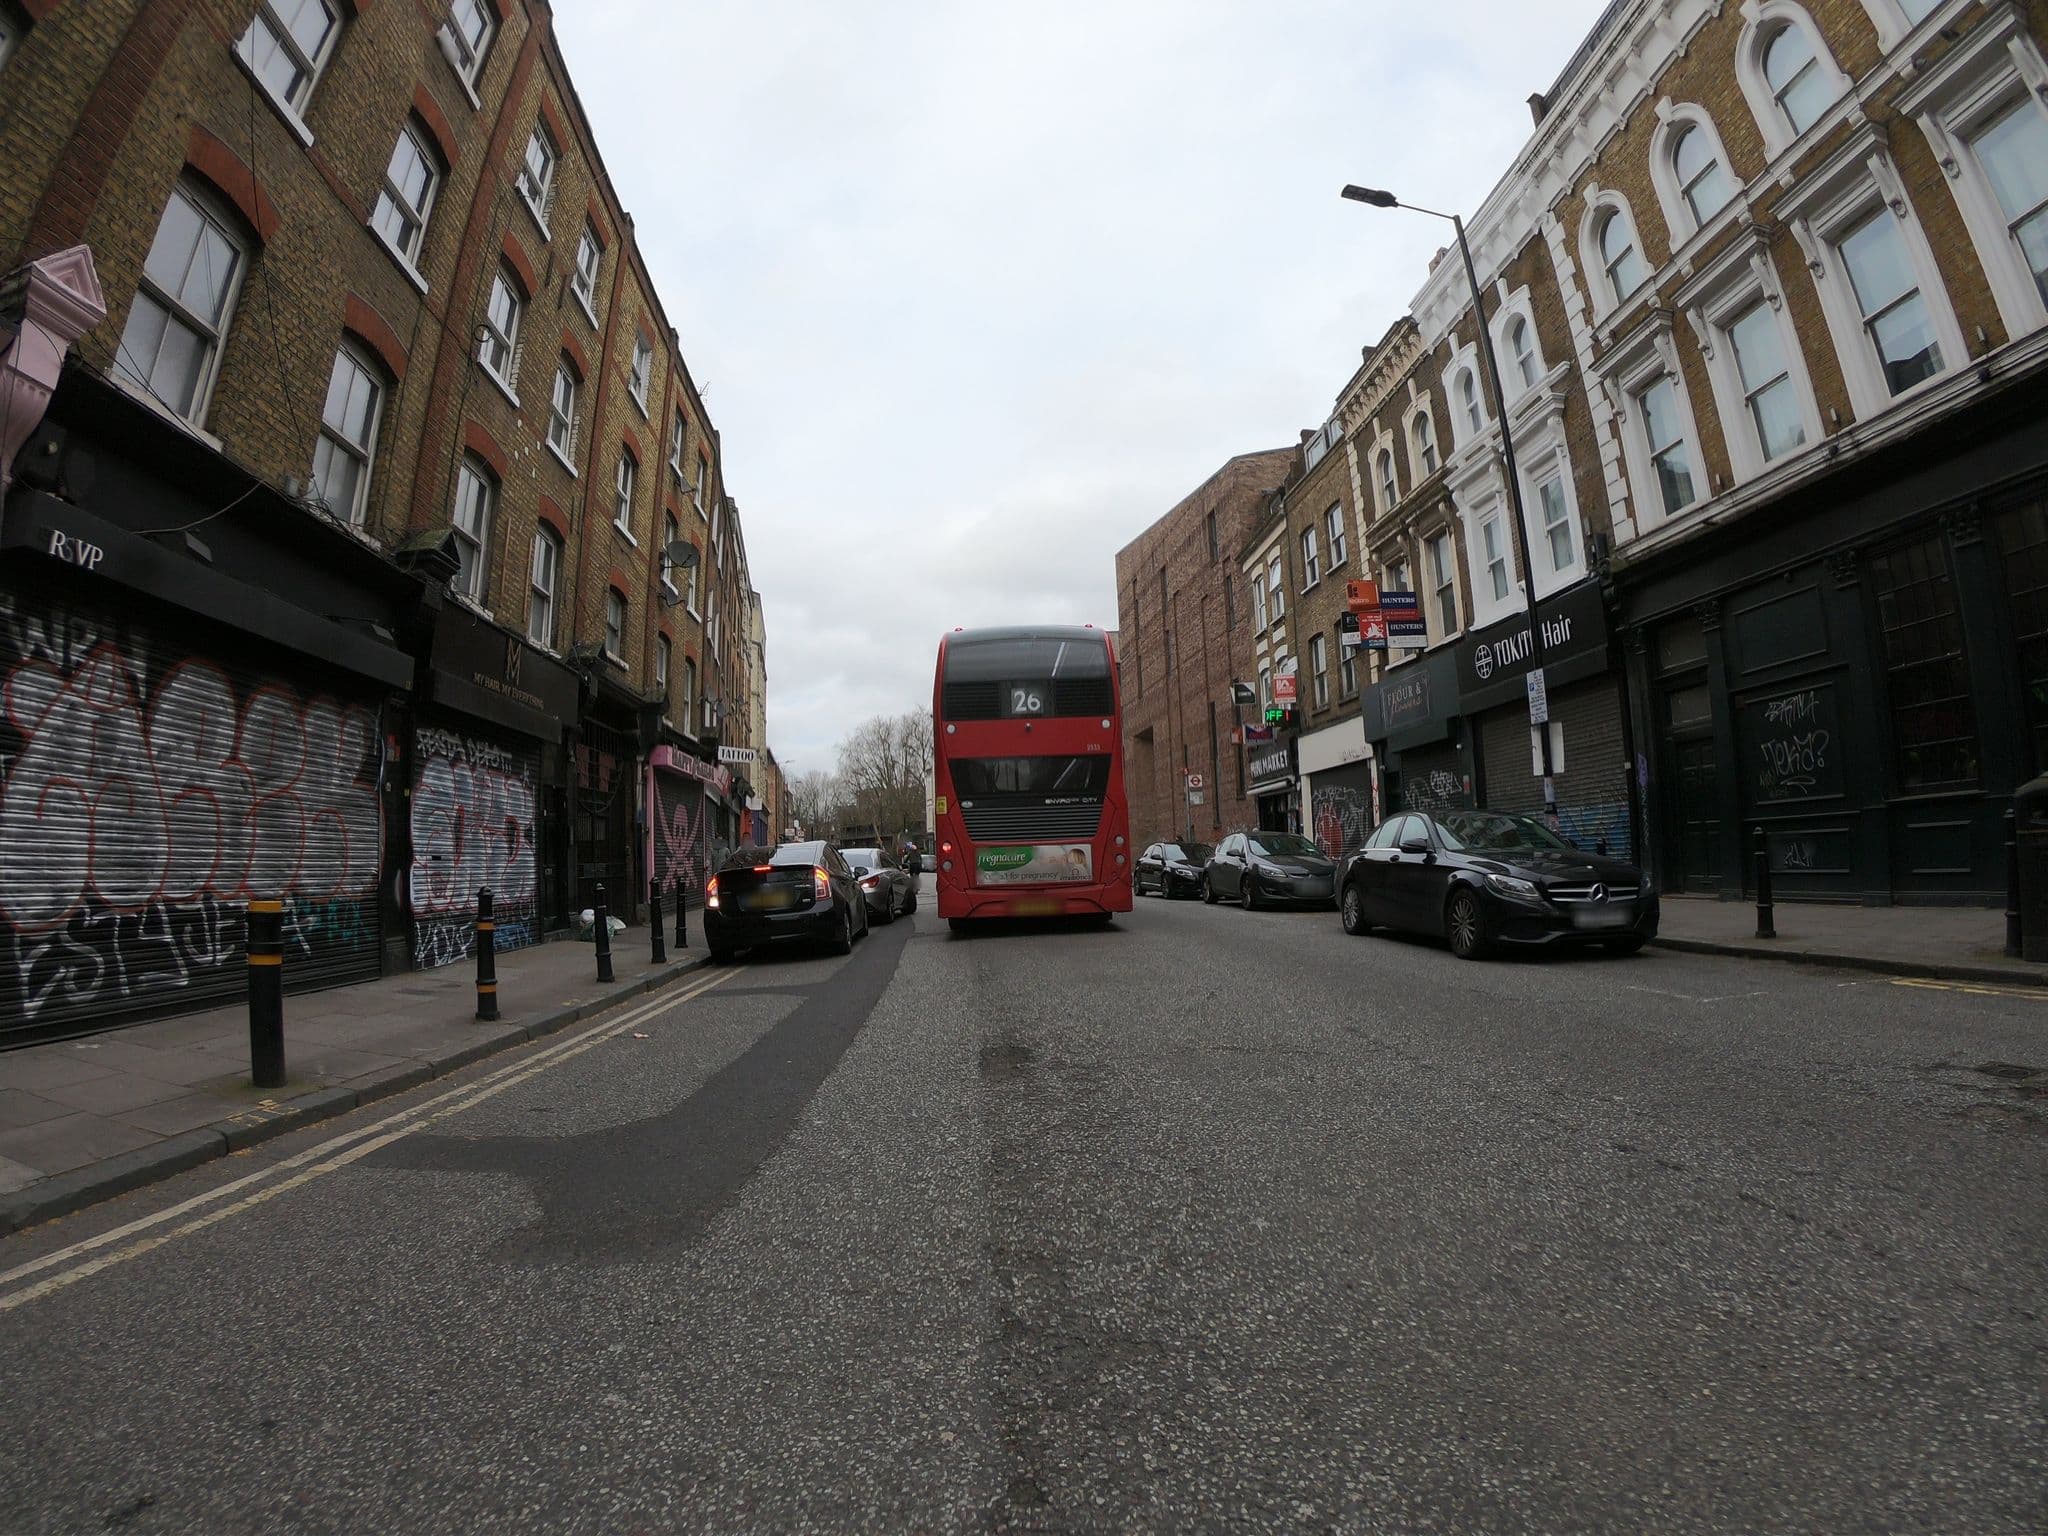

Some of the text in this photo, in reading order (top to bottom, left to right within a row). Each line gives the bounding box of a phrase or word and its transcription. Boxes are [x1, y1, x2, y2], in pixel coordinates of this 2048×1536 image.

[1541, 614, 1571, 650] Hair
[1014, 690, 1041, 712] 26
[720, 748, 754, 761] TATTOO
[1262, 749, 1288, 775] MARKET
[1008, 871, 1020, 880] for
[1021, 871, 1058, 881] pregnancy
